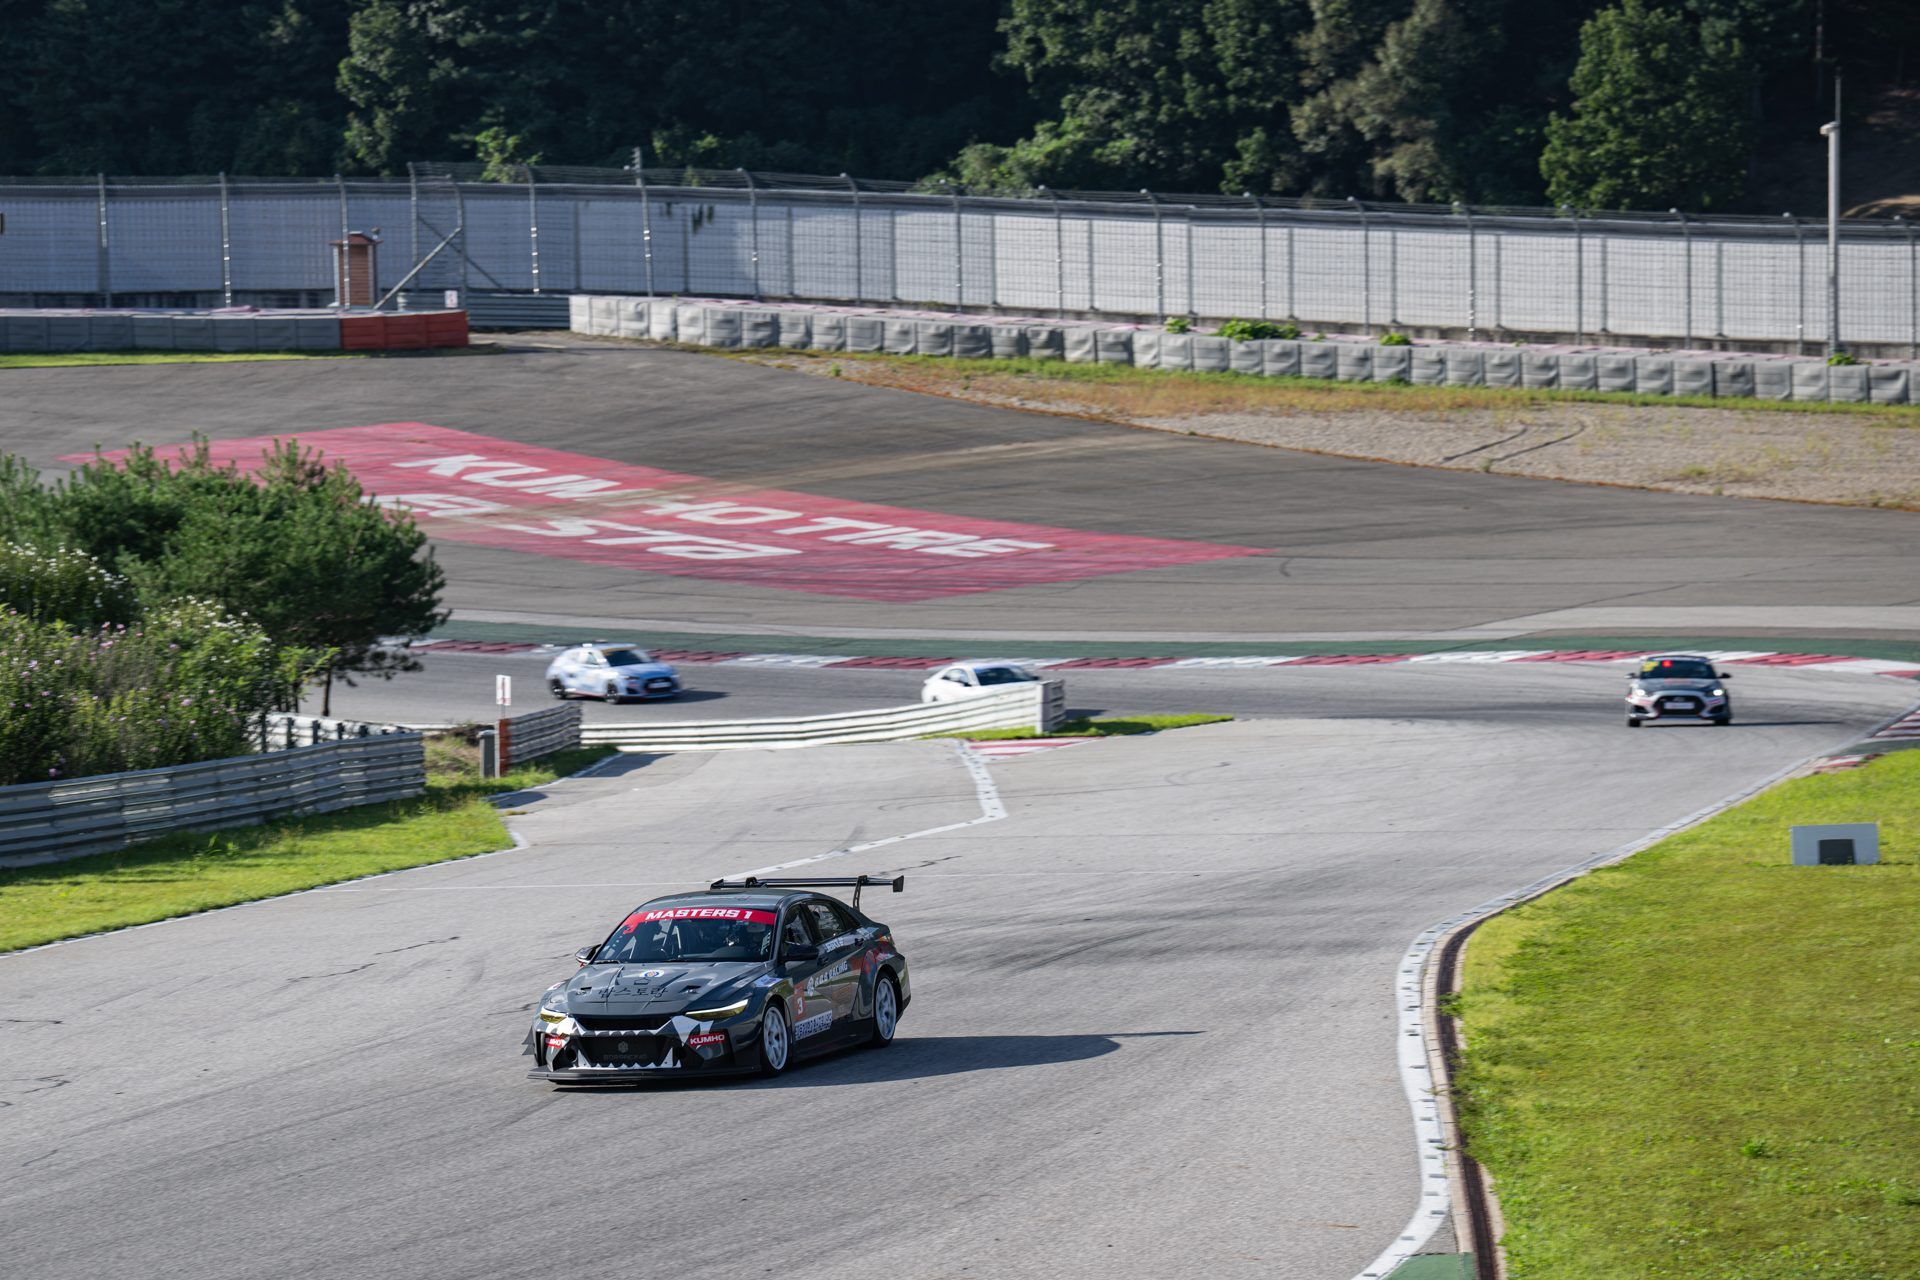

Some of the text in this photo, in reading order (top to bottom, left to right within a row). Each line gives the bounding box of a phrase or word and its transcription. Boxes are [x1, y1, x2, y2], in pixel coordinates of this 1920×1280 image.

[392, 453, 1055, 558] KUMHO TIRE
[645, 908, 753, 921] MASTERS 1
[797, 997, 804, 1015] 3
[690, 1034, 725, 1045] KUMHO
